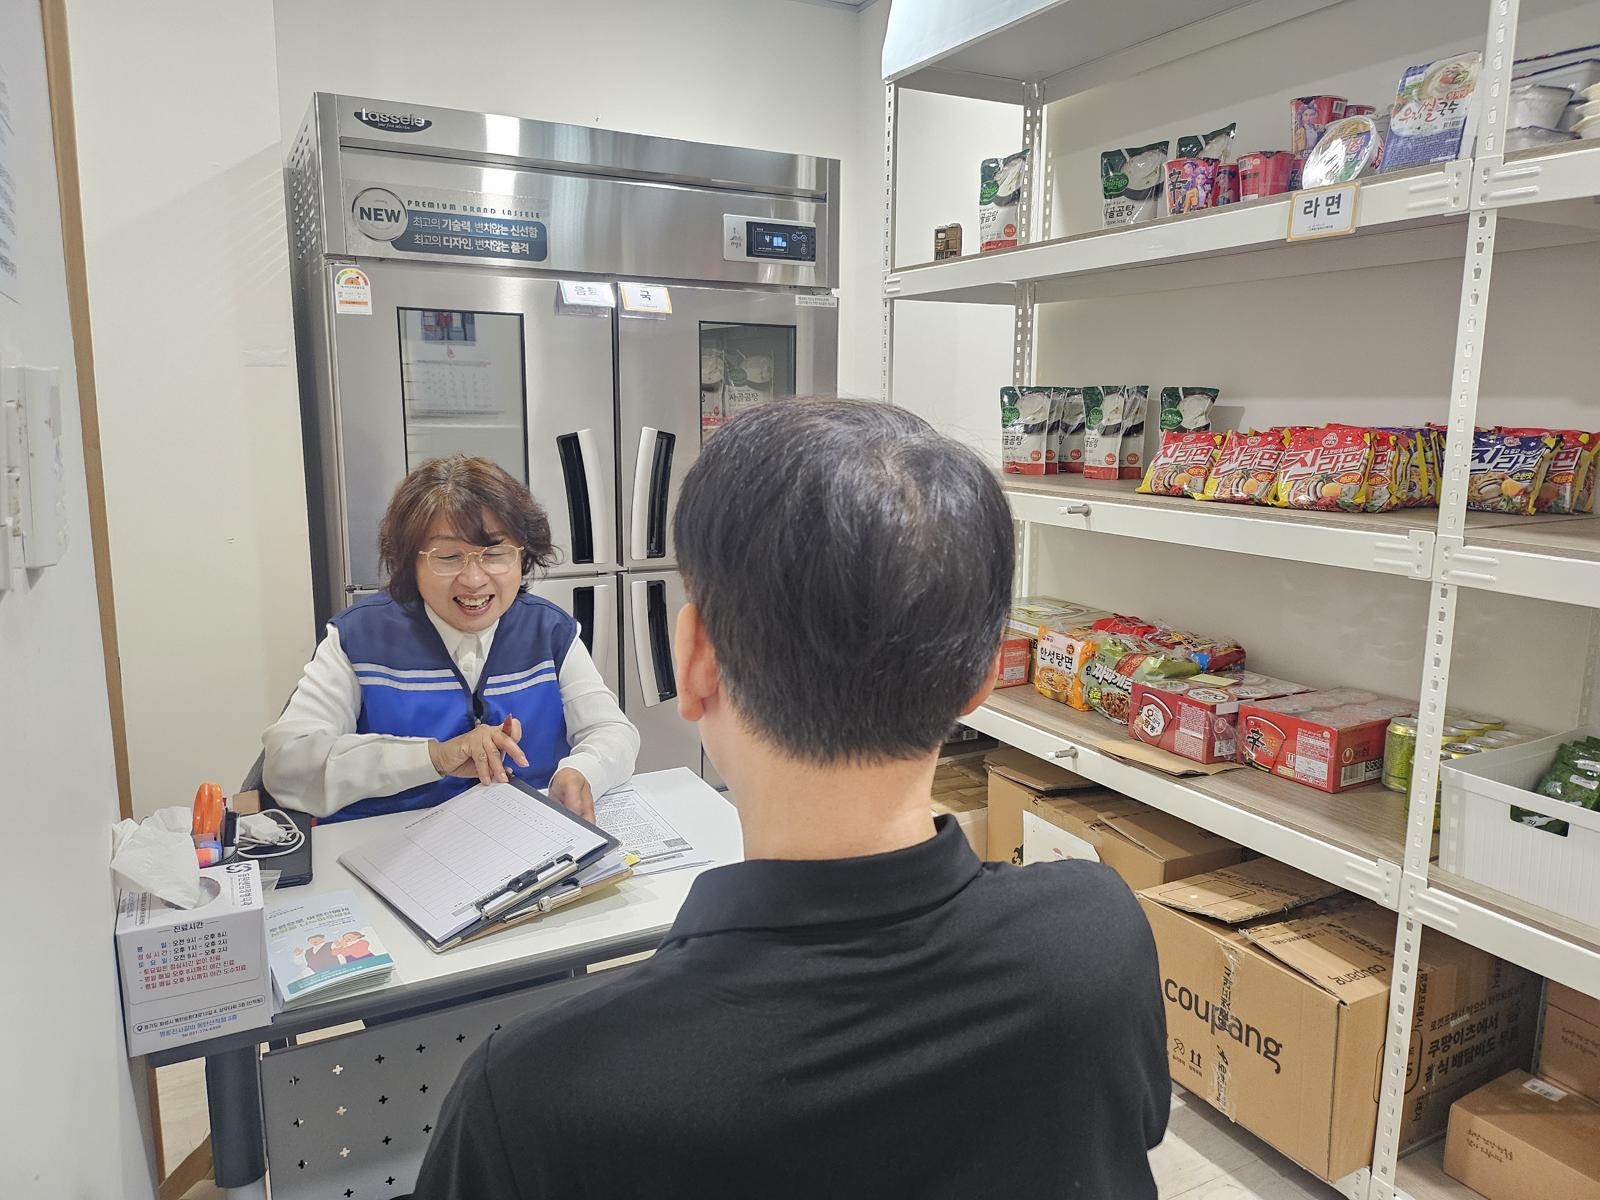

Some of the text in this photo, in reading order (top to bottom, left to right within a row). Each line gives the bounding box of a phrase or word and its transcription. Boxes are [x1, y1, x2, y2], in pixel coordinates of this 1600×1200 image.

[359, 206, 401, 223] NEW
[407, 200, 457, 211] PREMIUM
[1303, 192, 1342, 218] 라면
[412, 216, 441, 229] 최고의
[511, 225, 538, 238] 신선함
[413, 233, 441, 247] 최고의
[511, 242, 529, 254] 품격
[640, 289, 651, 301] 국
[1152, 442, 1214, 469] 진라면
[1214, 446, 1285, 478] 진라면
[1280, 447, 1367, 481] 진라면
[1040, 647, 1073, 670] 안성탕면
[173, 921, 204, 933] 진료시간
[203, 933, 216, 941] 오후
[173, 954, 185, 962] 오전
[173, 969, 185, 977] 오후
[173, 977, 185, 985] 오후
[1164, 978, 1283, 1075] coupang
[1427, 1014, 1499, 1058] 쿠팡이츠에서
